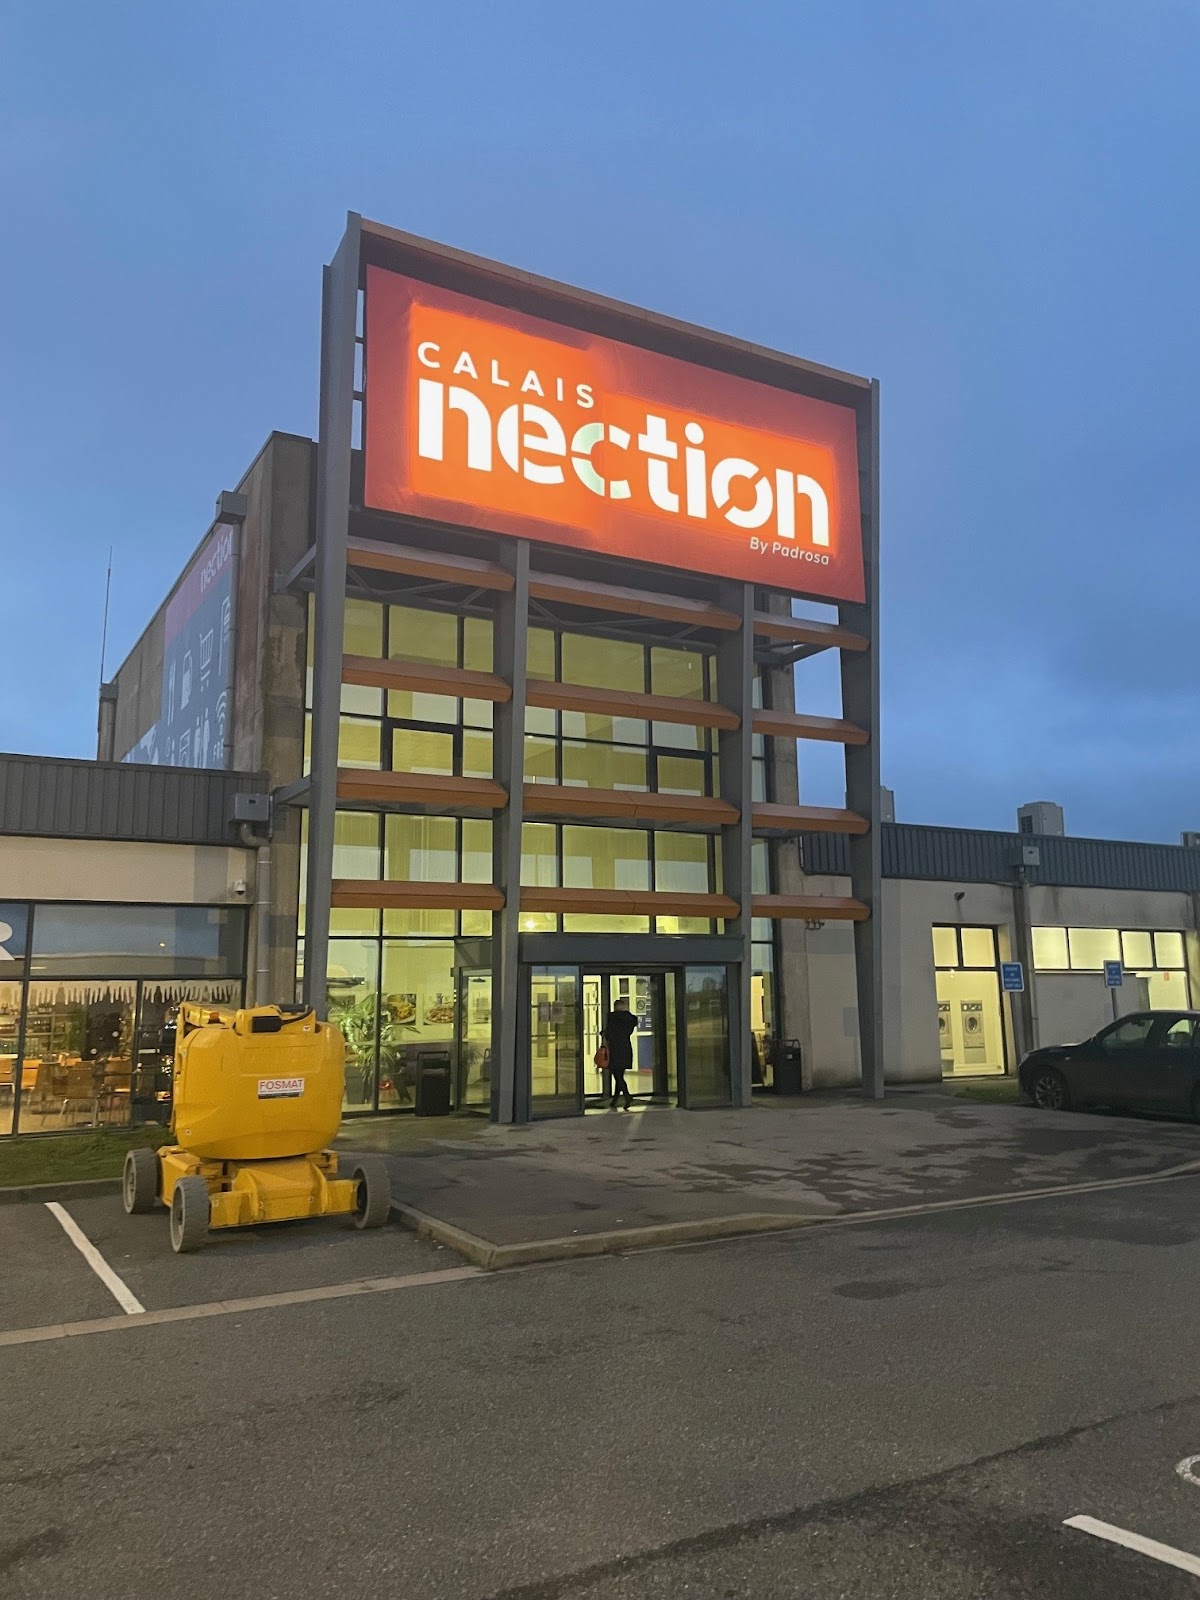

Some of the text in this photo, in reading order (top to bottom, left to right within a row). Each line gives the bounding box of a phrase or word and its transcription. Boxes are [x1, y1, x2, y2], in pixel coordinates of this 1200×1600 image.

[417, 341, 594, 409] CALAIS
[418, 377, 830, 548] nection
[750, 536, 830, 566] By Padrosa
[260, 1079, 303, 1090] FOSMAT
